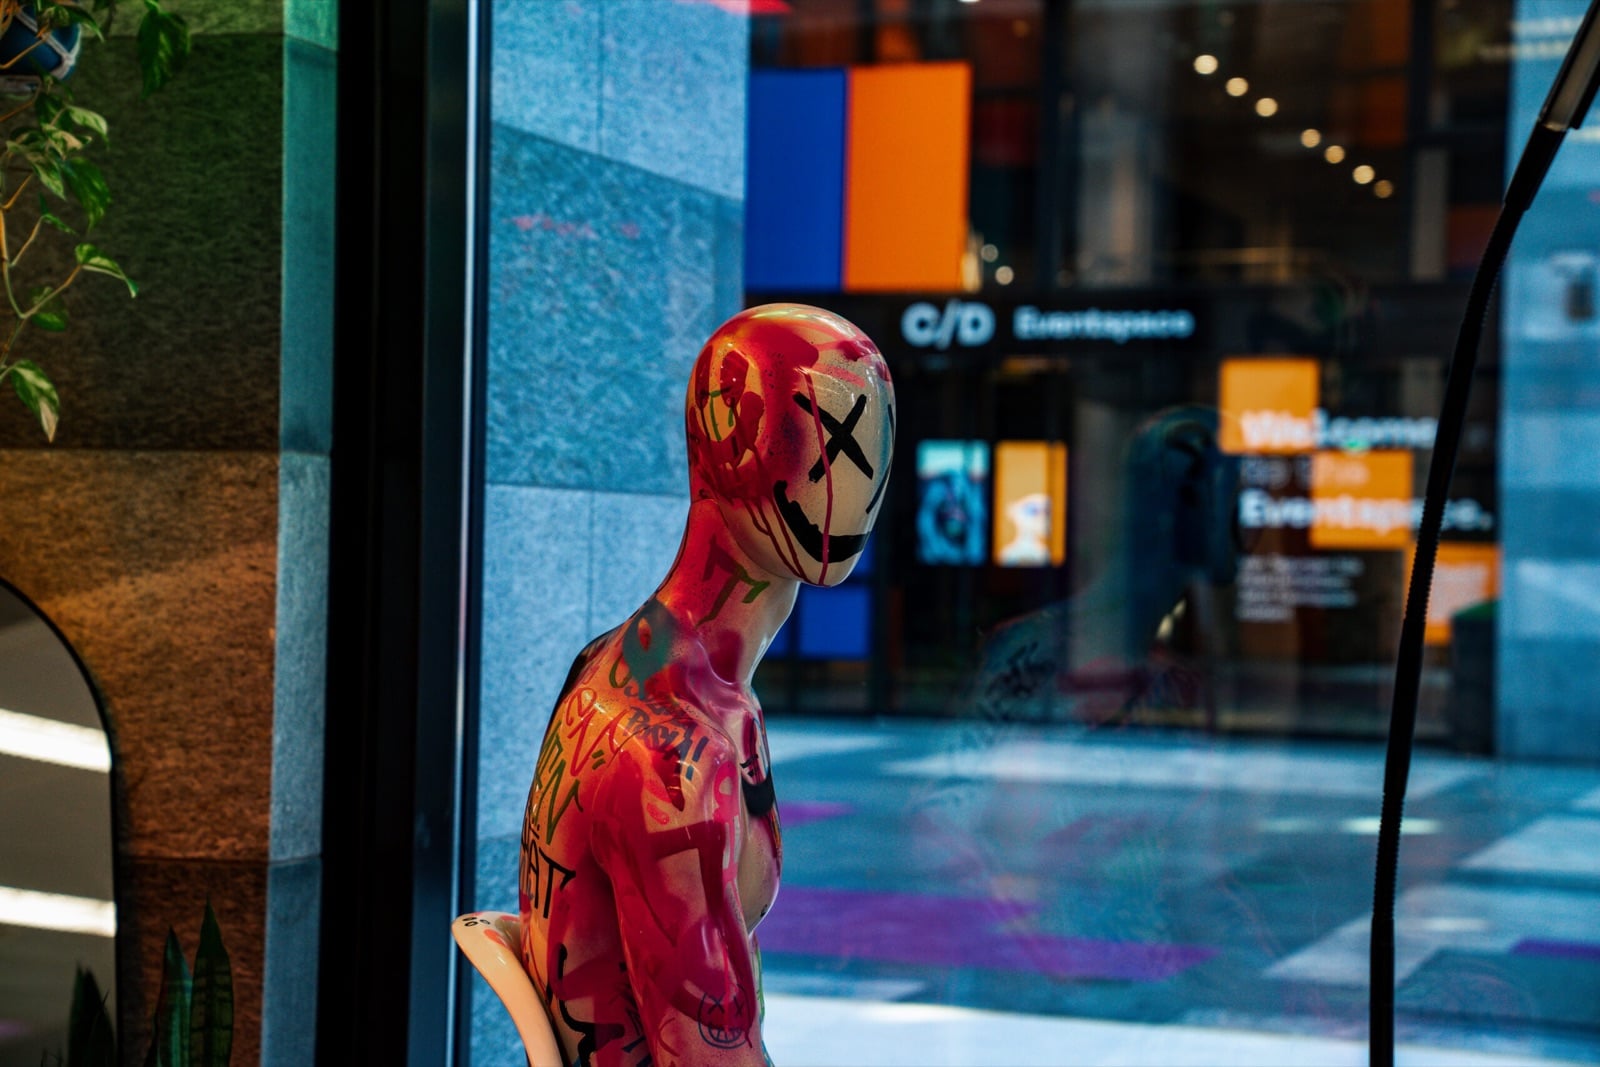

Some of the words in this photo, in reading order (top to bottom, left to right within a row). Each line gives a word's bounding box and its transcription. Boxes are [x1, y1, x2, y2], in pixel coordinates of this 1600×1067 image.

[901, 299, 995, 349] C/D
[1013, 306, 1195, 343] Eventspace
[1239, 490, 1493, 536] Eventspae.
